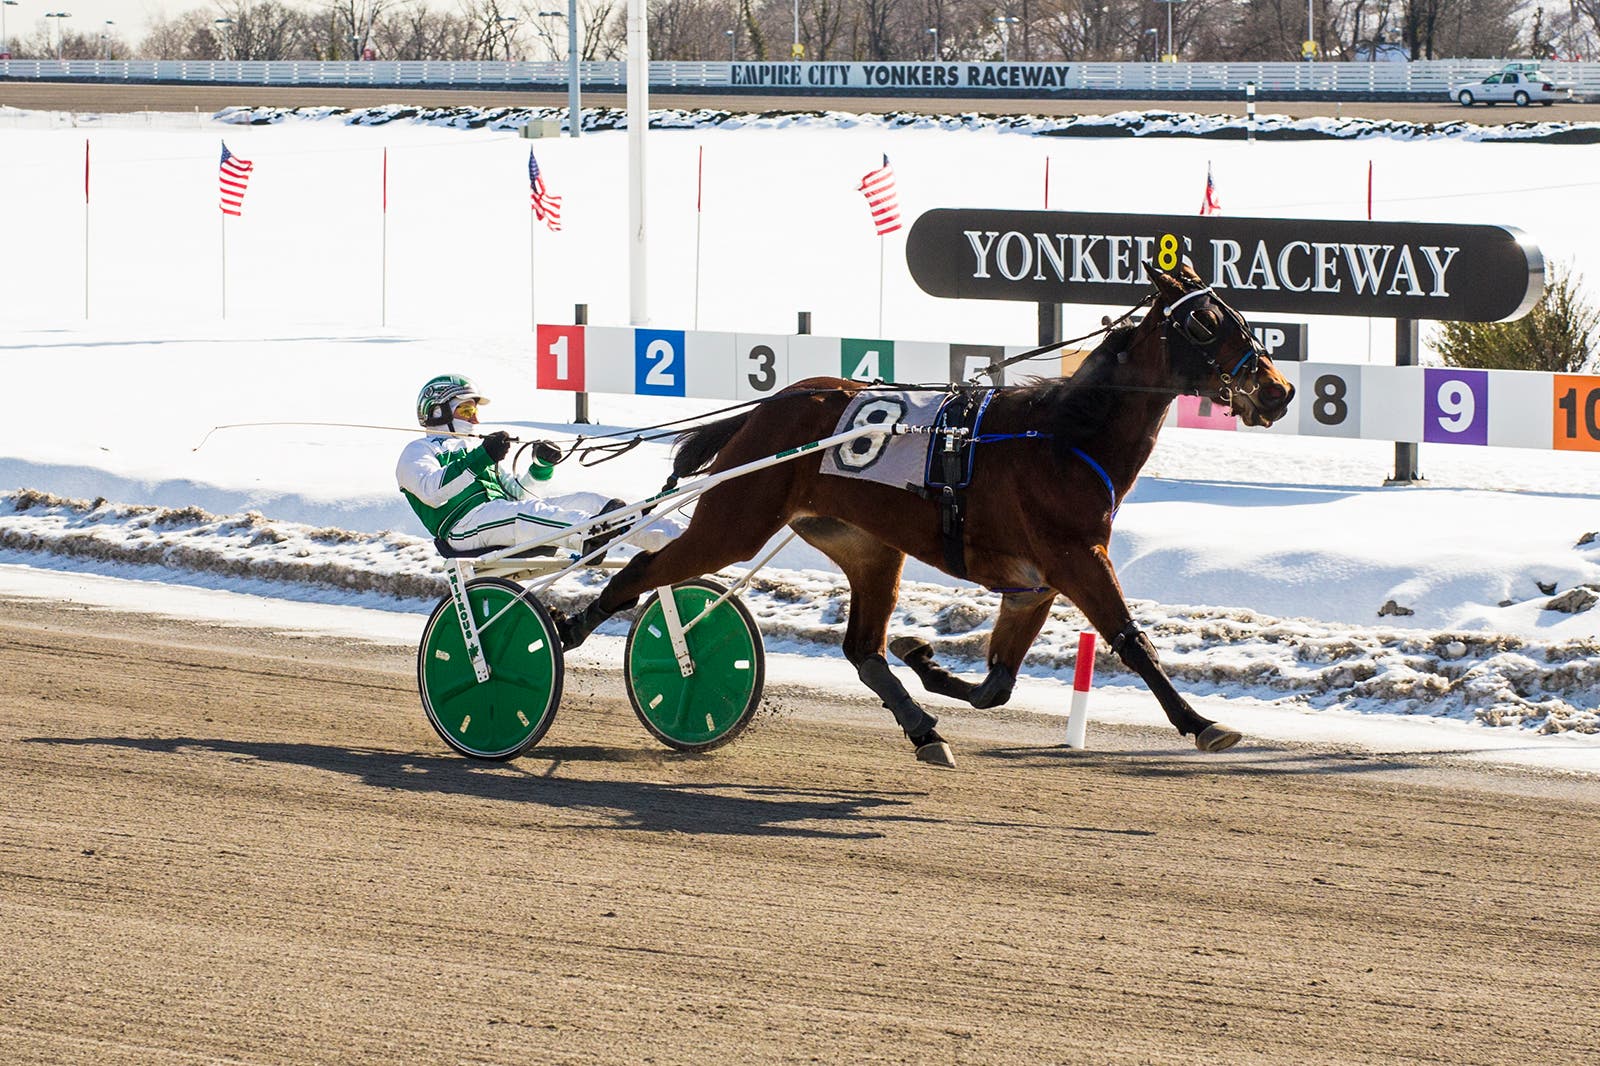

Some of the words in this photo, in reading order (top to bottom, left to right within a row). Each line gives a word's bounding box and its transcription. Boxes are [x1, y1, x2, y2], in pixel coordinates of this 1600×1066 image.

[730, 64, 801, 86] EMPIRE
[808, 64, 851, 86] CITY
[862, 65, 959, 87] YONKERS
[967, 65, 1070, 88] RACEWAY
[1157, 233, 1179, 271] 8
[1210, 238, 1459, 298] RACEWAY
[549, 335, 568, 380] 1
[646, 339, 675, 386] 2
[748, 345, 777, 392] 3
[1312, 374, 1348, 426] 8
[1437, 379, 1475, 433] 9
[833, 397, 908, 473] 8
